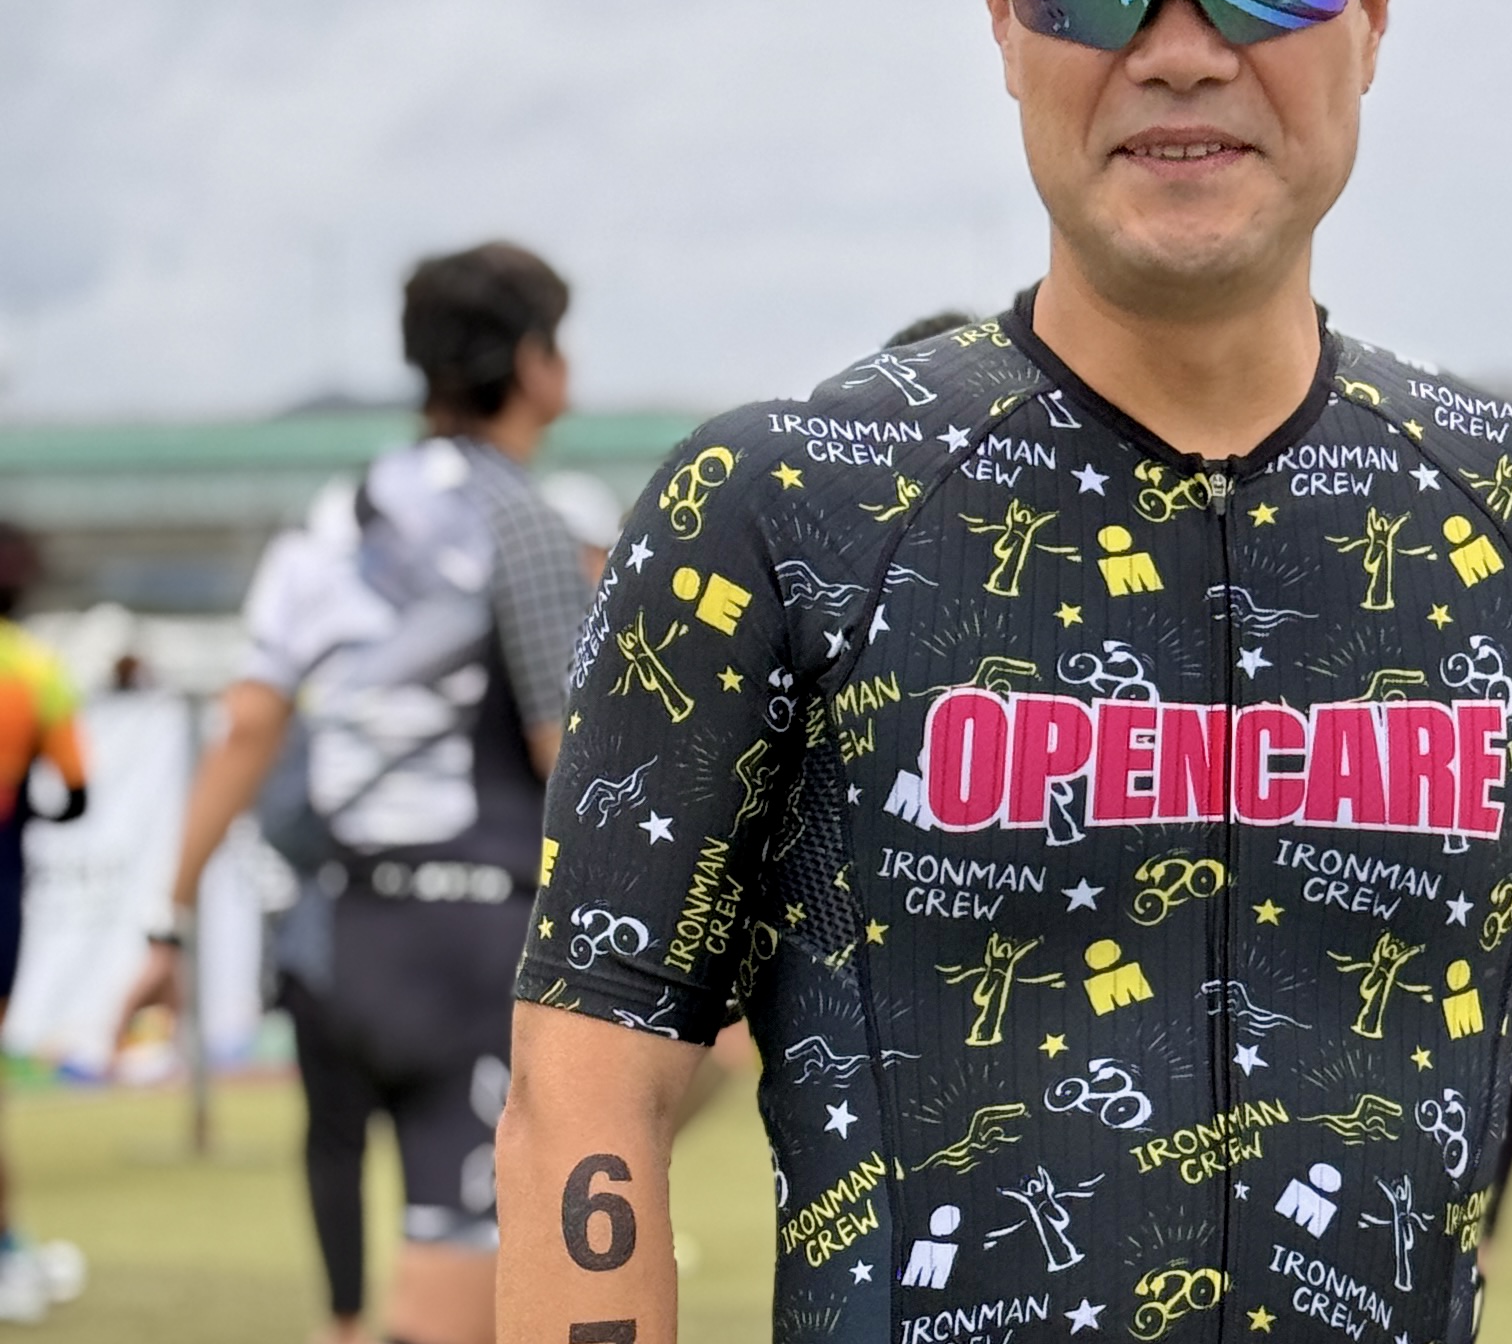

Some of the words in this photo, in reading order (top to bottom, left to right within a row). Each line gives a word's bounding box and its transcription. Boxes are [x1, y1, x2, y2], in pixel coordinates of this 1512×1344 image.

[767, 413, 923, 443] IRONMAN
[806, 439, 893, 468] CREW
[1434, 406, 1510, 444] CREW
[1290, 471, 1374, 497] CREW
[575, 609, 610, 689] CREW
[925, 686, 1508, 841] OPENCARE
[876, 847, 1047, 894] IRONMAN
[1272, 838, 1443, 901] IRONMAN
[1302, 876, 1402, 922] CREW
[663, 835, 730, 975] IRONMAN
[705, 873, 744, 955] CREW
[905, 885, 1004, 922] CREW
[1128, 1097, 1291, 1175] IRONMAN
[1180, 1130, 1264, 1185] CREW
[780, 1150, 887, 1255] IRONMAN
[805, 1198, 880, 1268] CREW
[1268, 1243, 1394, 1332] IRONMAN
[1292, 1286, 1368, 1342] CREW
